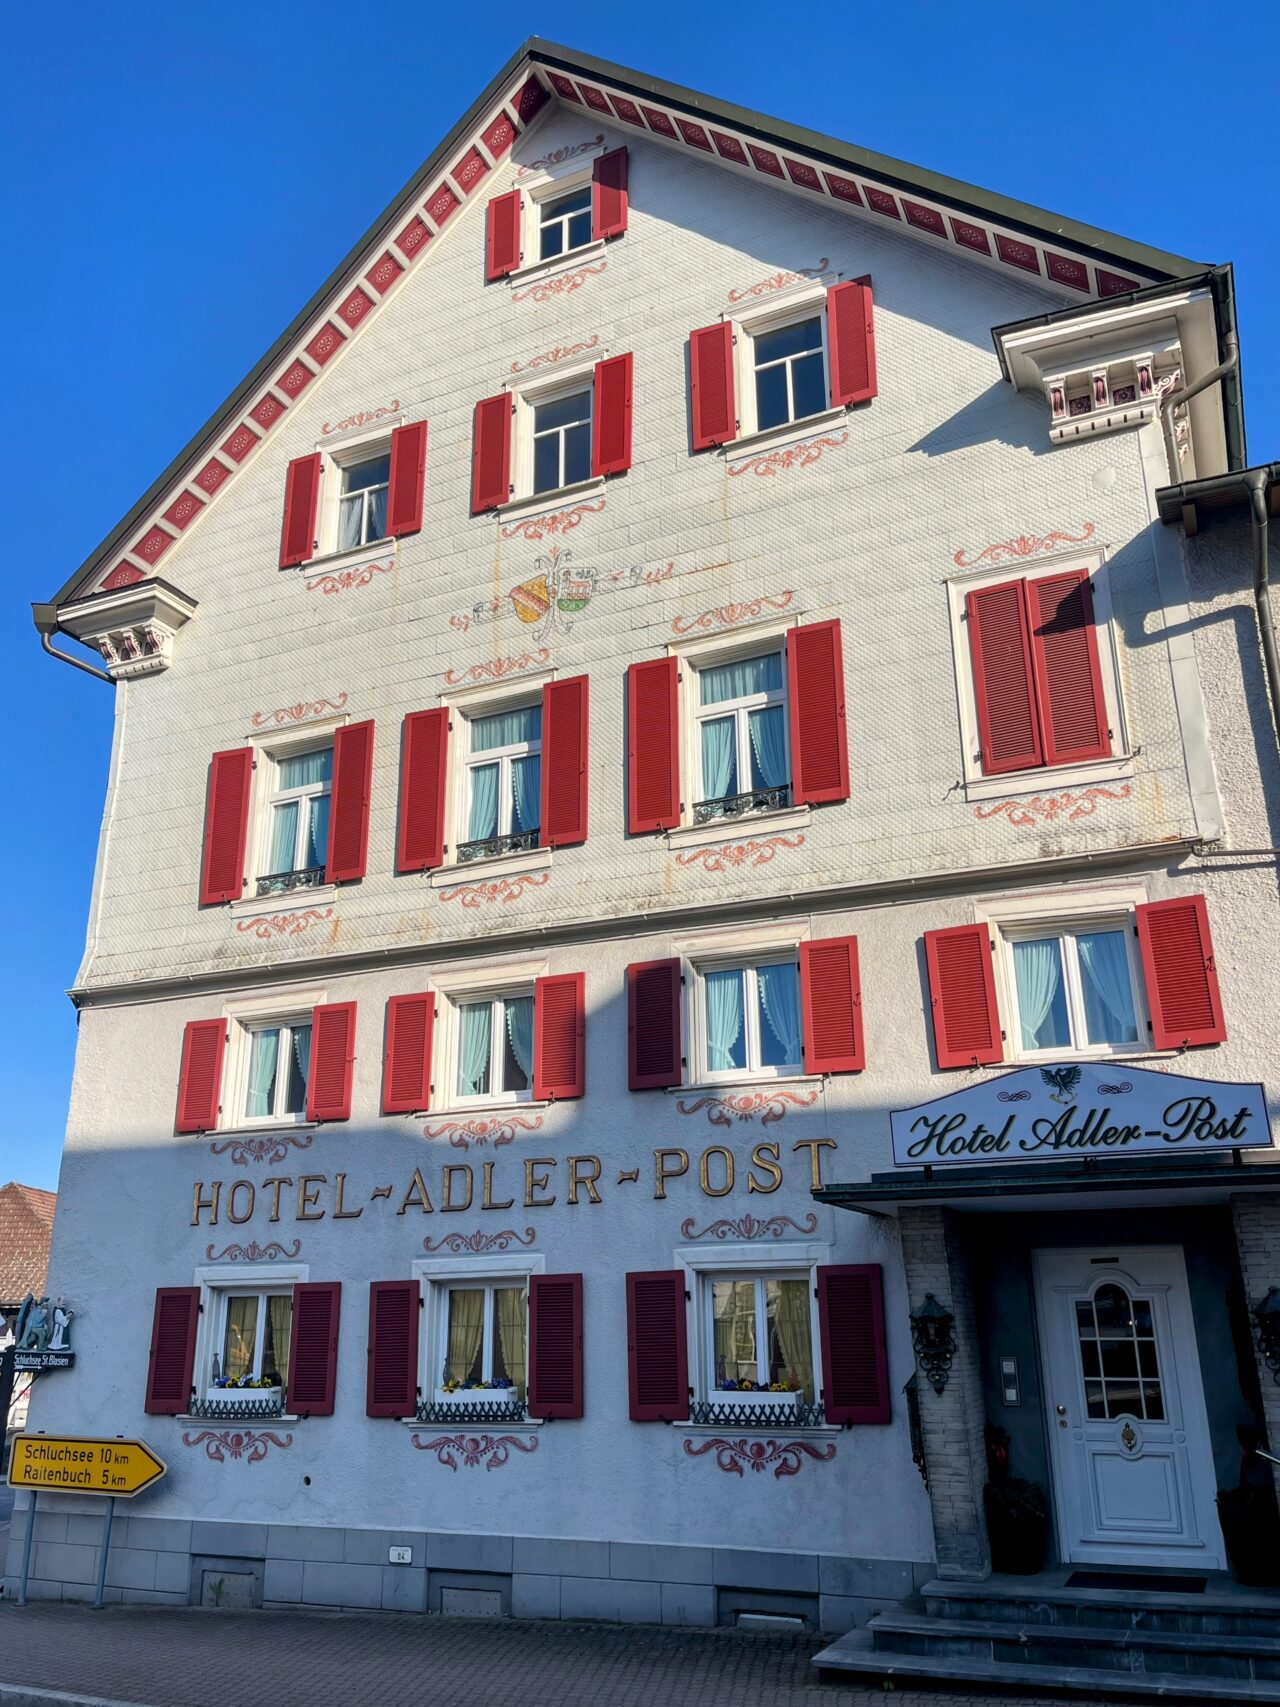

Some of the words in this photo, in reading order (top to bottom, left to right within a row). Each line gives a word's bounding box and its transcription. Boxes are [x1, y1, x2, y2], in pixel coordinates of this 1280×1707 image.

[907, 1112, 1016, 1158] Hotel
[14, 1354, 41, 1365] Schluchsee
[25, 1444, 94, 1463] Schluchsee
[100, 1448, 112, 1464] 10
[114, 1452, 129, 1465] km
[23, 1464, 91, 1484] Raitenbuch
[101, 1469, 110, 1485] 5
[111, 1473, 126, 1487] km
